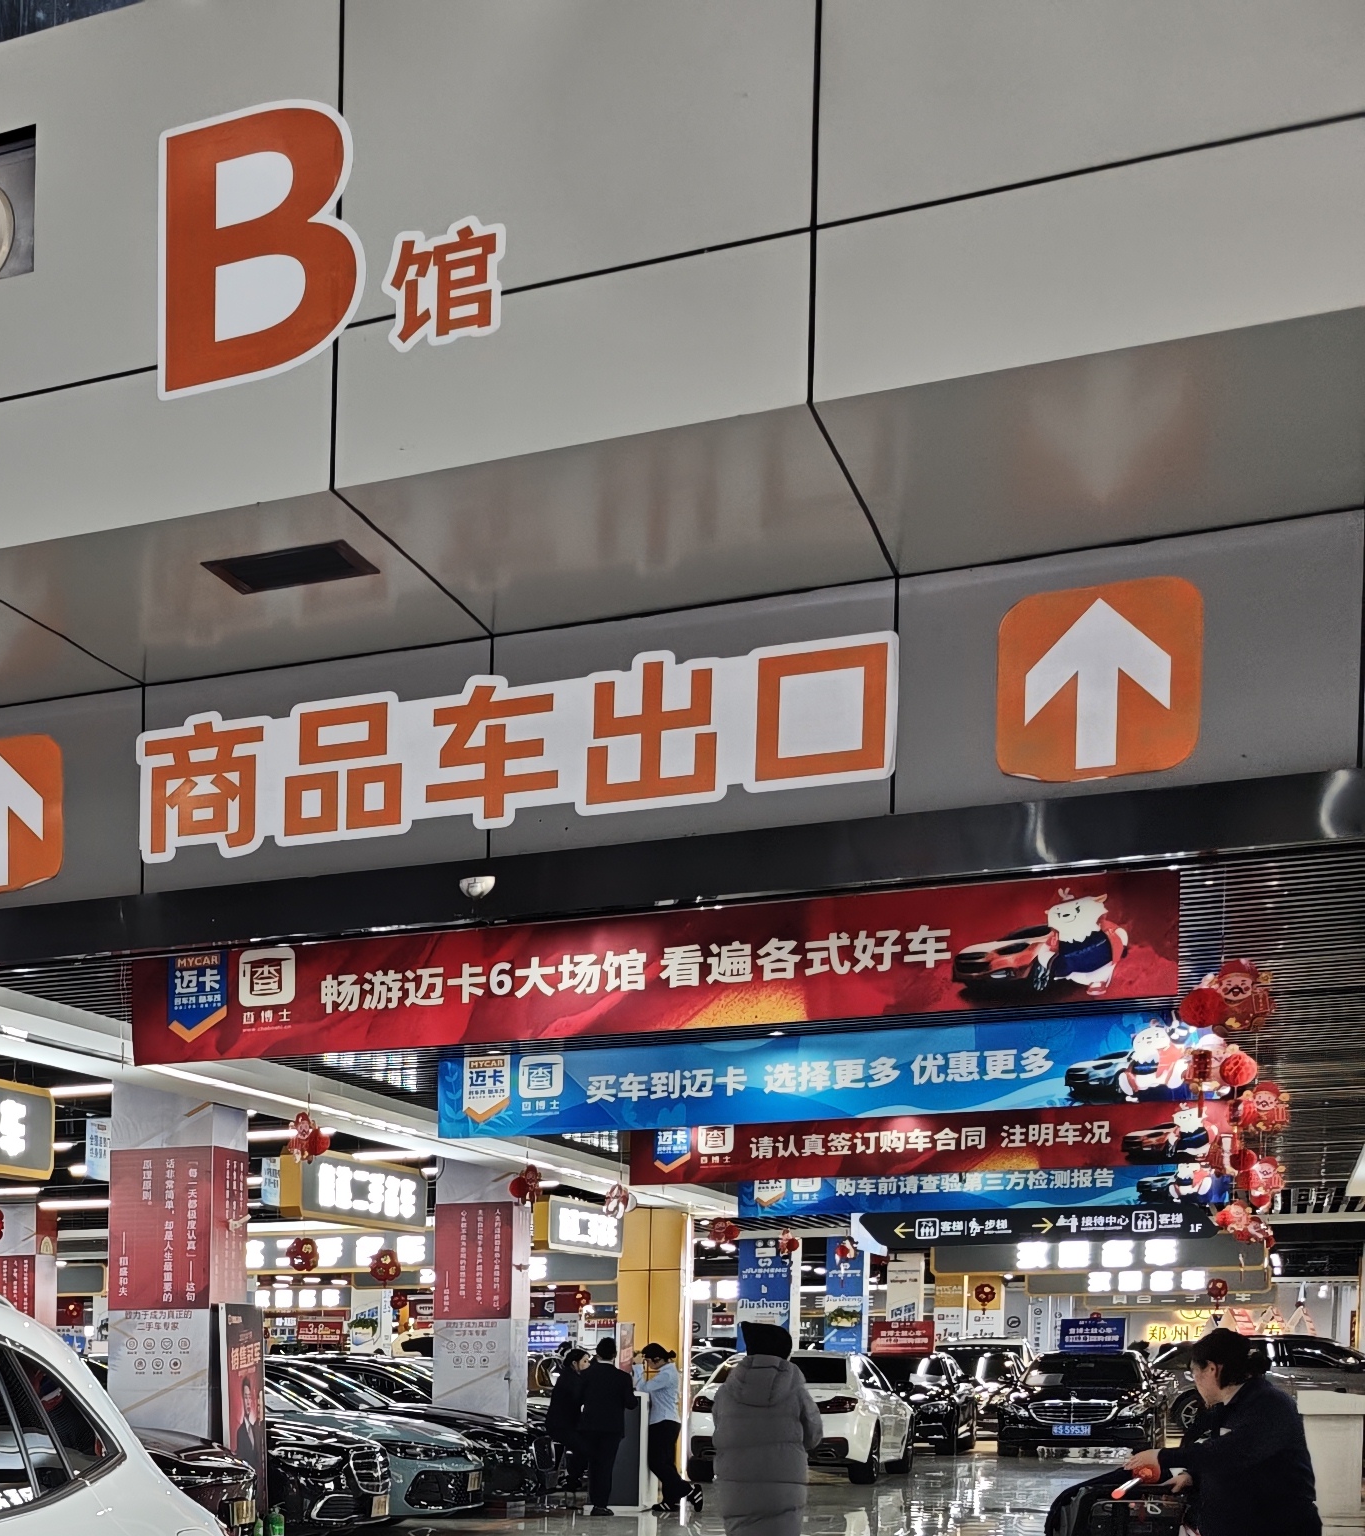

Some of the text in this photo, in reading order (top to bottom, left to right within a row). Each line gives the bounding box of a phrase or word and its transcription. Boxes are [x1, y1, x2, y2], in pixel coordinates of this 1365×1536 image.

[162, 103, 499, 395] B馆
[141, 634, 895, 862] 商品车出口
[177, 955, 219, 968] MYCAR
[319, 924, 952, 1014] 畅游迈卡6大场馆 看遍各式好车
[174, 968, 221, 994] 迈卡
[470, 1060, 504, 1068] MYCAR
[469, 1069, 505, 1088] 迈卡
[587, 1046, 1054, 1104] 买车到迈卡 选择更多 优惠更多
[657, 1131, 688, 1145] 迈卡
[749, 1120, 1112, 1160] 请认真签订购车合同 注明车况
[834, 1168, 1115, 1197] 购车前请查验第三方检测报告
[940, 1213, 1202, 1233] 客梯 步梯 接待中心 客梯 1F
[124, 1310, 193, 1320] 致力于成为真正的
[738, 1299, 789, 1311] Jiusheng
[136, 1321, 180, 1332] 二手车专家
